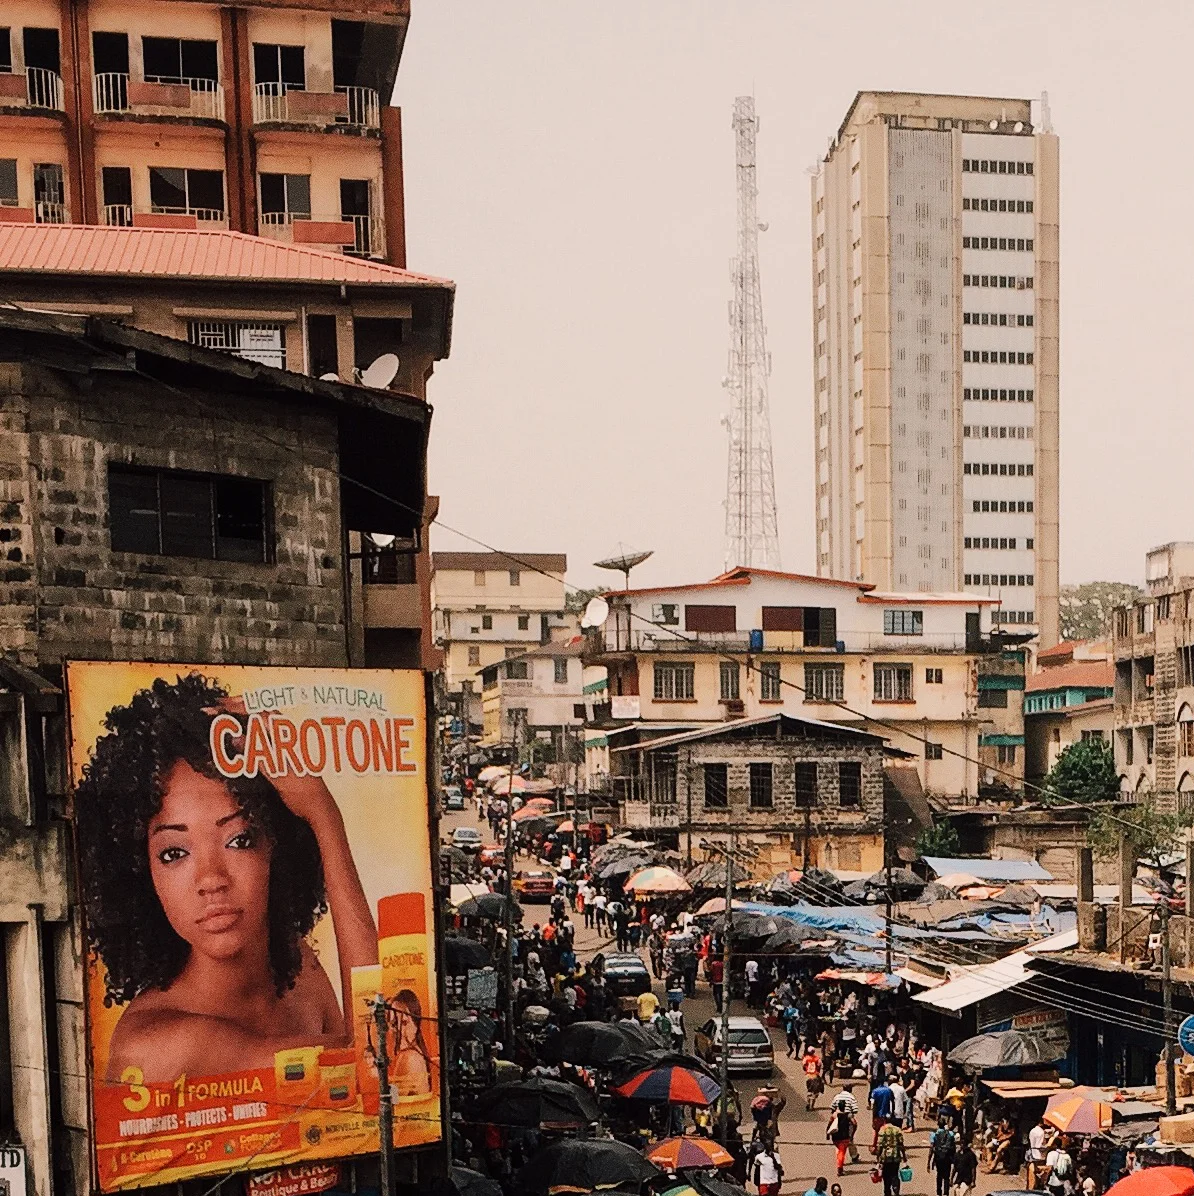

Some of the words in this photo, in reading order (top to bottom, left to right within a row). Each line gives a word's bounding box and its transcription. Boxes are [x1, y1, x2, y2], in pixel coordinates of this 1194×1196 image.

[245, 686, 295, 710] LIGHT
[313, 685, 388, 712] NATURAL
[212, 715, 417, 776] CAROTONE
[120, 1065, 151, 1112] 3
[154, 1088, 171, 1108] in
[173, 1073, 187, 1108] 1
[187, 1076, 264, 1102] FORMULA
[300, 1179, 309, 1191] &
